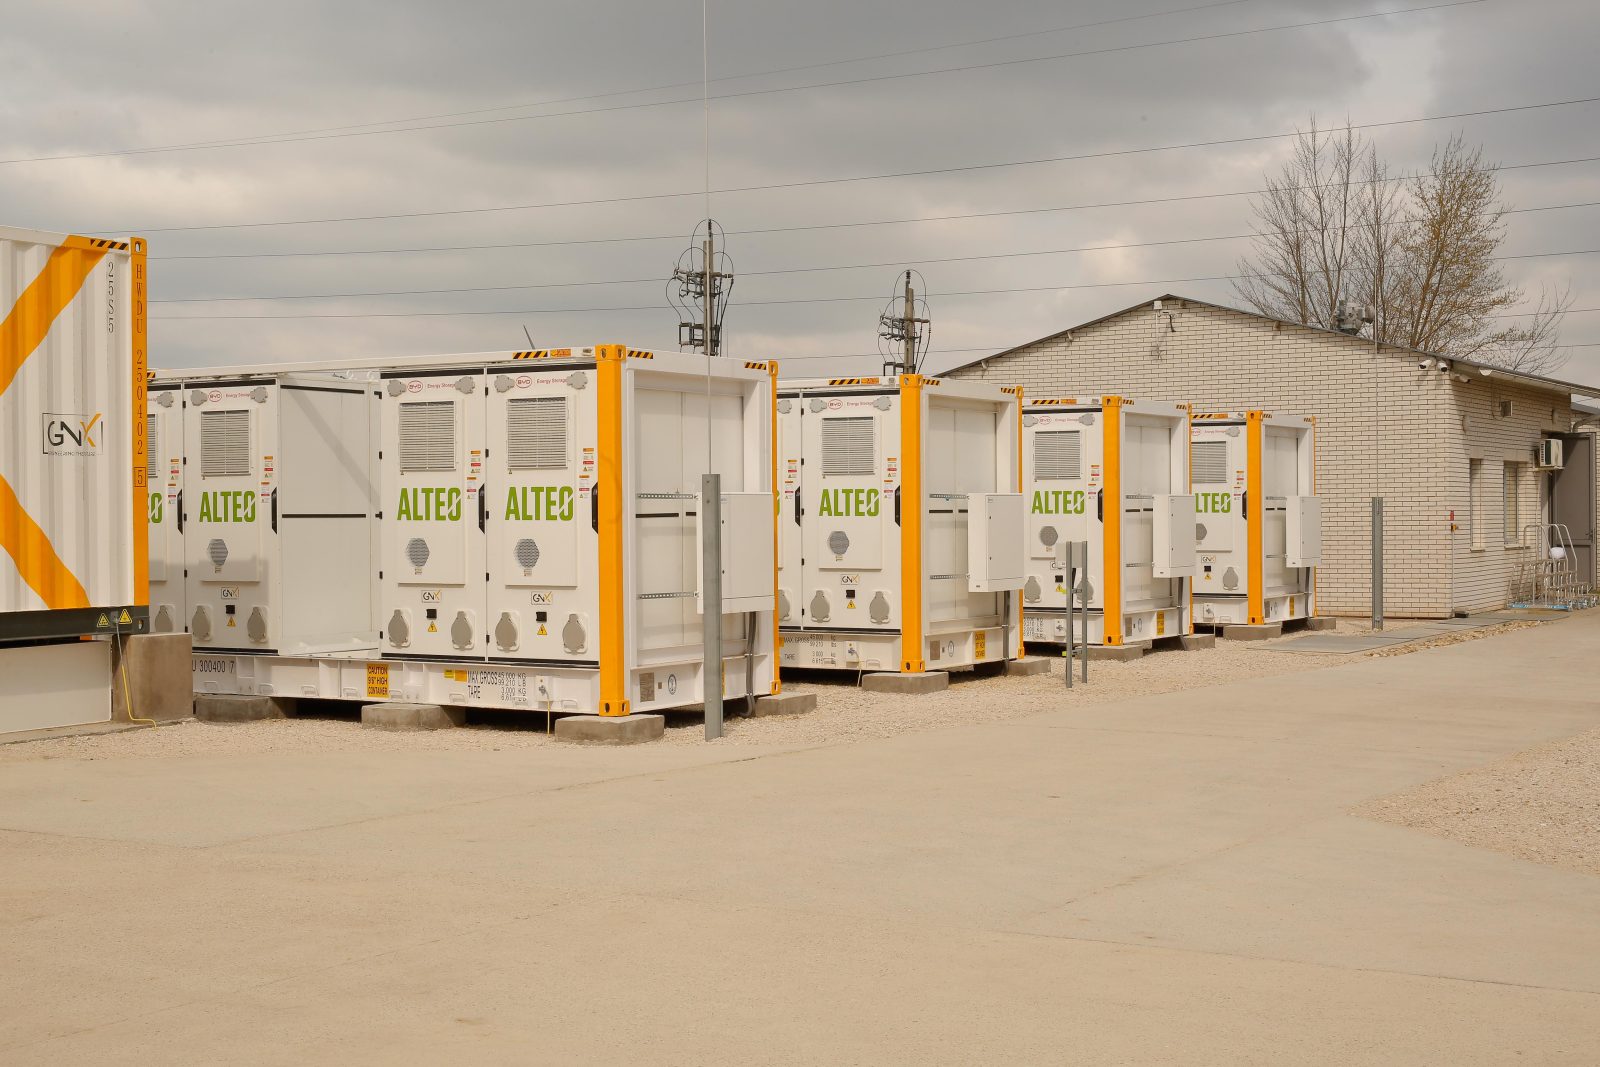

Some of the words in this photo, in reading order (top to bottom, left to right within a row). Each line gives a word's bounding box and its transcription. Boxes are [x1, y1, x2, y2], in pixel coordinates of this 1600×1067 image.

[199, 490, 256, 523] ALTEO
[397, 487, 462, 521] ALTEO
[505, 486, 574, 521] ALTEO
[818, 488, 879, 516] ALTEO
[1031, 490, 1085, 514] ALTEO
[1195, 492, 1231, 513] LTEO
[199, 659, 226, 673] 300400
[368, 666, 388, 675] CAUTION
[377, 676, 388, 685] HIGH
[480, 671, 498, 685] GROSS
[517, 672, 527, 680] KG
[467, 685, 481, 699] TARE
[518, 687, 527, 695] KG
